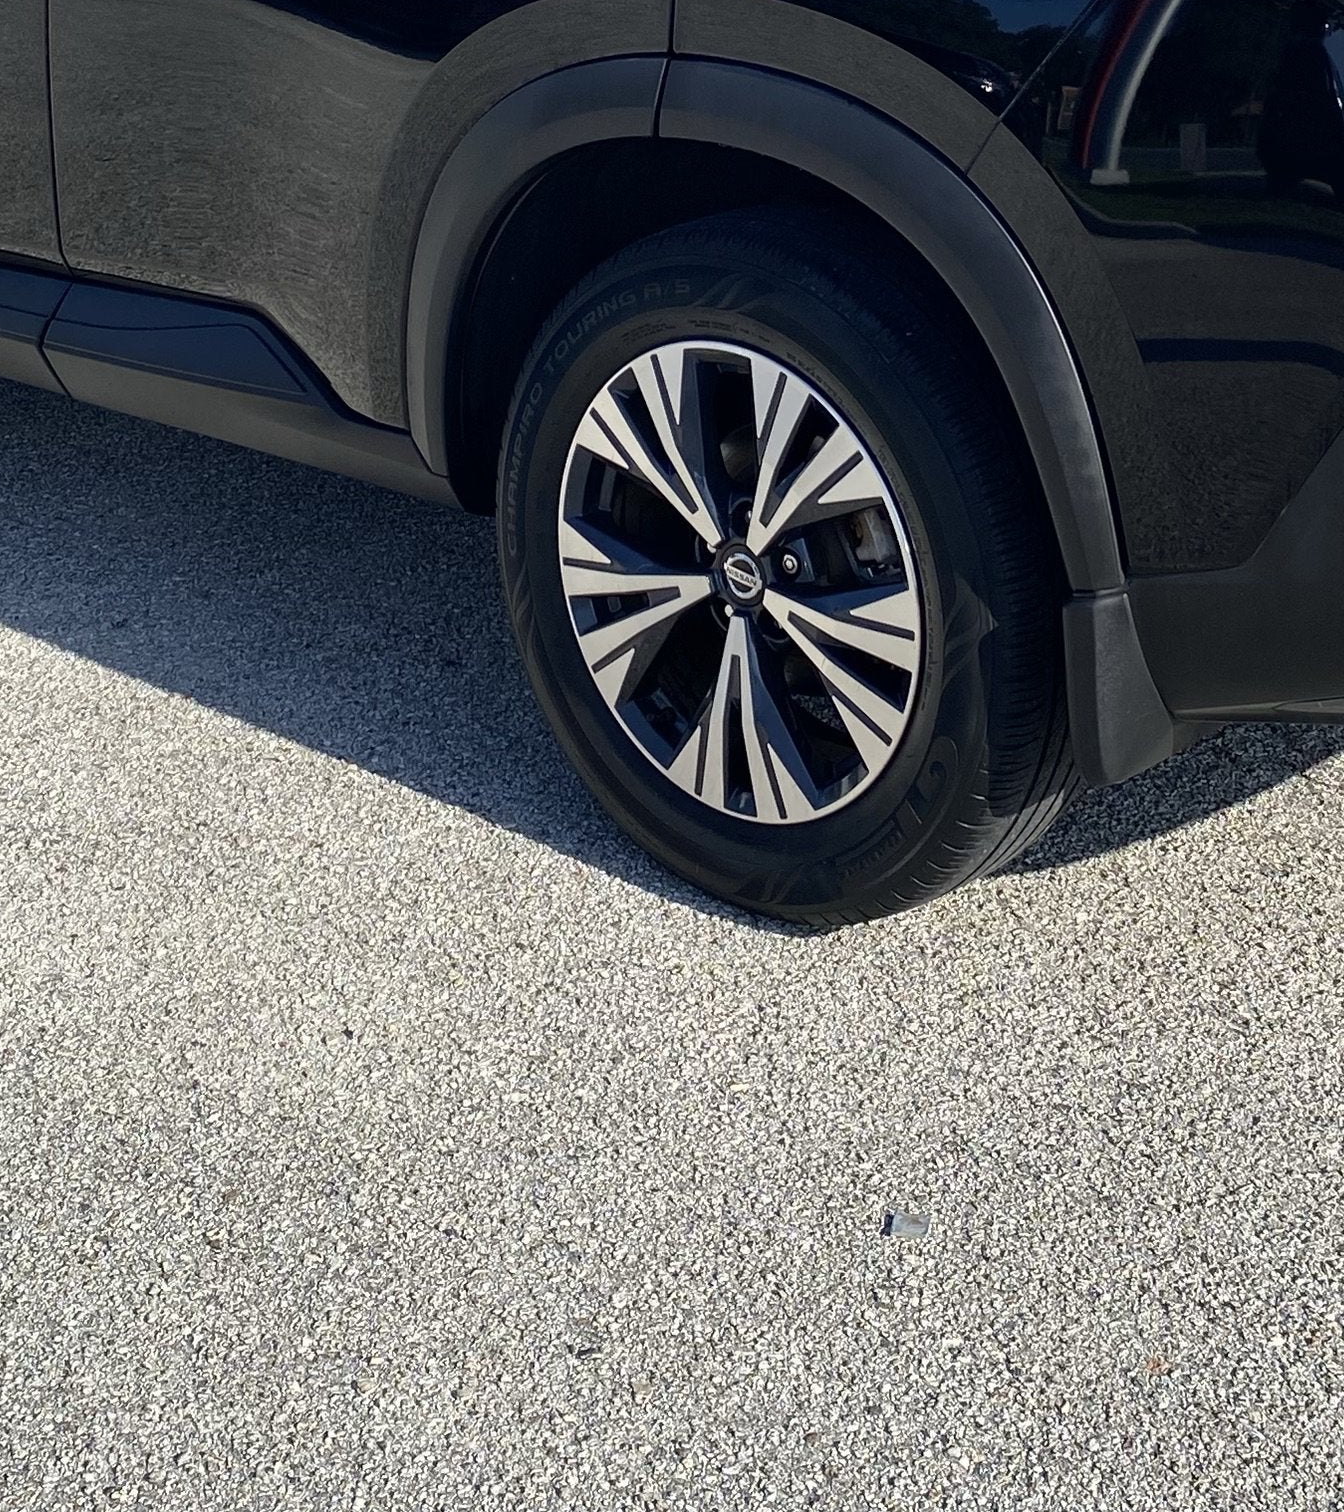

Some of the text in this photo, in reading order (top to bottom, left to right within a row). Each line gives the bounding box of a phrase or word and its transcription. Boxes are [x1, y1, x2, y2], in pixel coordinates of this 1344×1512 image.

[506, 381, 544, 558] CHAMPIRO
[543, 288, 637, 375] TOURING
[726, 566, 758, 587] NISSAN
